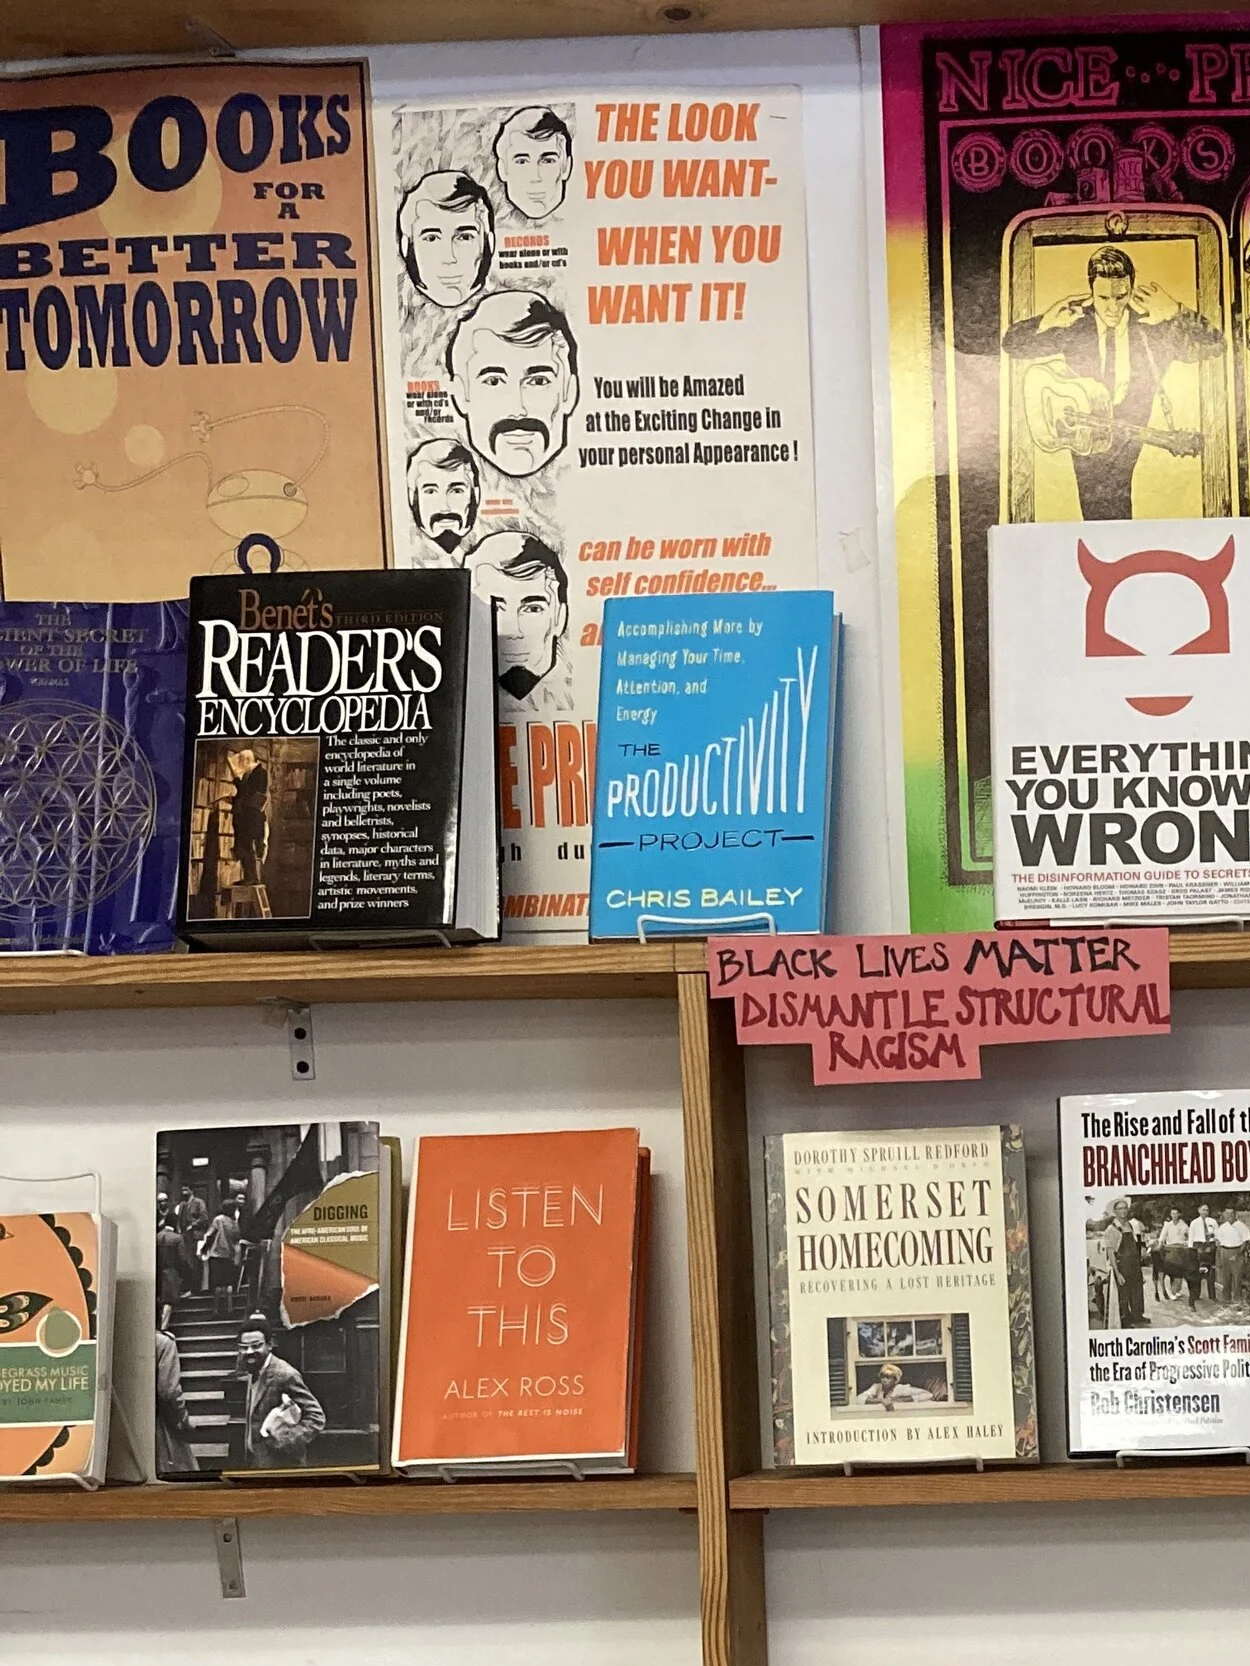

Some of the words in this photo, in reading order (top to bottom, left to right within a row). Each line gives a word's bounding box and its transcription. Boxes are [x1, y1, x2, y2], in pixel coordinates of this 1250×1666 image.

[936, 47, 1120, 112] NICE
[596, 103, 660, 141] THE
[668, 103, 759, 141] LOOK
[0, 92, 351, 234] BOOKS
[584, 160, 655, 199] YOU
[664, 159, 777, 198] WANT-
[254, 183, 325, 201] FOR
[278, 203, 299, 220] A
[0, 232, 356, 279] BETTER
[0, 278, 358, 371] TOMORROW
[594, 376, 627, 398] You
[627, 377, 655, 397] will
[660, 376, 677, 397] be
[683, 374, 744, 396] Amazed
[199, 619, 442, 699] READER'S
[198, 696, 432, 737] ENCYCLOPEDIA
[608, 645, 817, 819] PRODUCTIVITY
[618, 742, 661, 758] THE
[1007, 778, 1098, 810] YOU
[638, 829, 781, 851] PROJECT
[1011, 874, 1036, 883] THE
[1040, 871, 1141, 884] DISINFORMATION
[1143, 869, 1180, 881] GUIDE
[1182, 869, 1198, 880] TO
[718, 949, 838, 986] BLACK
[858, 942, 949, 978] LIVES
[965, 937, 1140, 976] MATTER
[741, 989, 950, 1029] DISMANTLE
[956, 983, 1171, 1027] STRUCTURAL
[829, 1032, 967, 1072] RACISM
[1082, 1112, 1110, 1138] The
[1113, 1111, 1148, 1137] Rise
[1152, 1110, 1183, 1136] and
[1187, 1108, 1216, 1134] Fall
[1220, 1108, 1235, 1134] of
[1083, 1142, 1217, 1187] BRANCHHEAD
[313, 1205, 369, 1221] DIGGING
[446, 1184, 603, 1233] LISTEN
[796, 1179, 991, 1224] SOMERSET
[487, 1245, 556, 1288] TO
[798, 1227, 993, 1272] HOMECOMING
[467, 1303, 569, 1348] THIS
[444, 1376, 510, 1399] ALEX
[519, 1375, 584, 1397] ROSS
